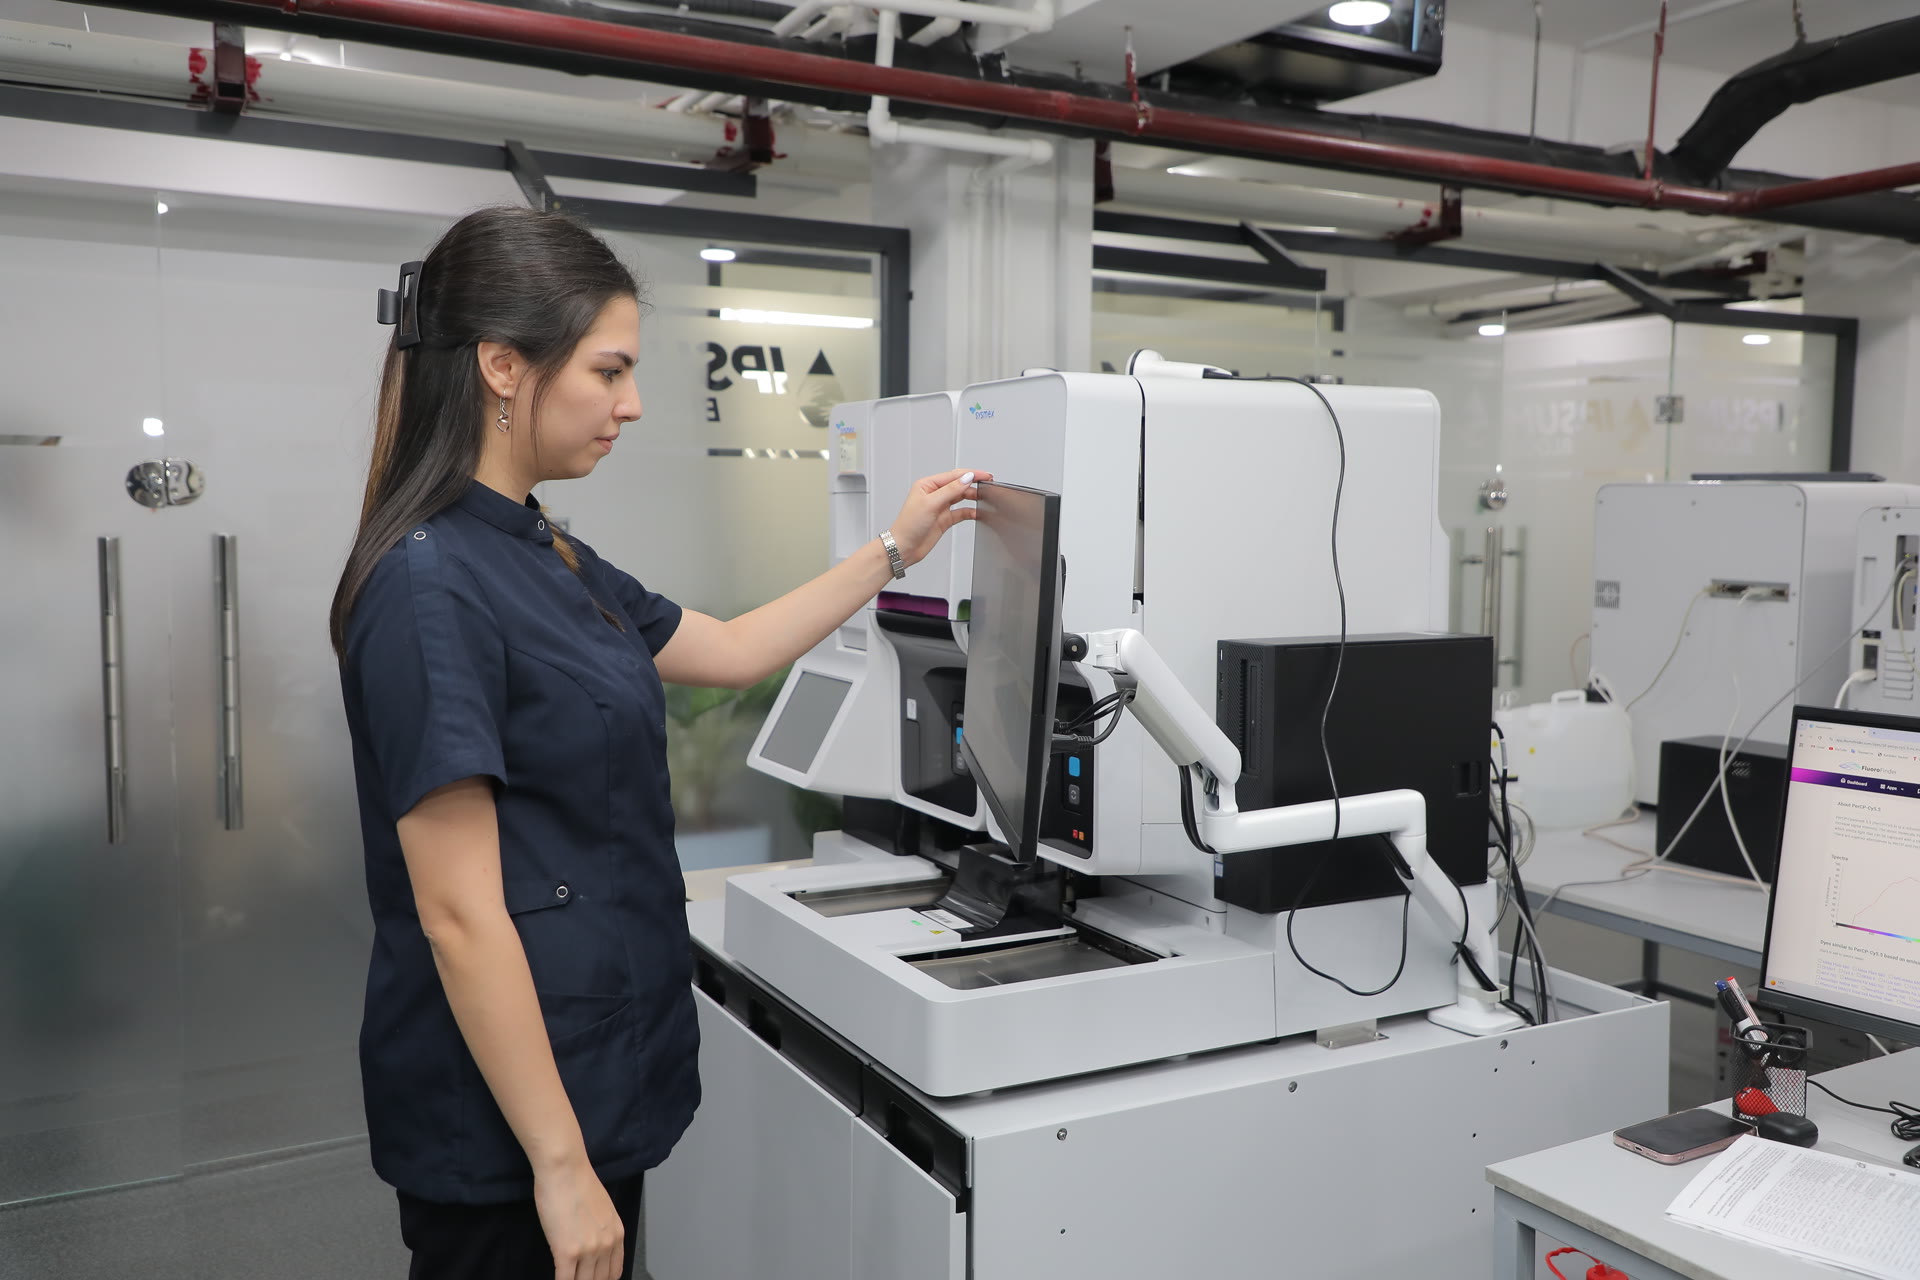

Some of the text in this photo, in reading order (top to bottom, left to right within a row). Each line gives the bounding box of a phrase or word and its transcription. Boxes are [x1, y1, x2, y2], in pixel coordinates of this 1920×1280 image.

[1861, 766, 1897, 775] FluoroFinder
[1847, 779, 1868, 787] Dashboard
[1884, 952, 1899, 961] based
